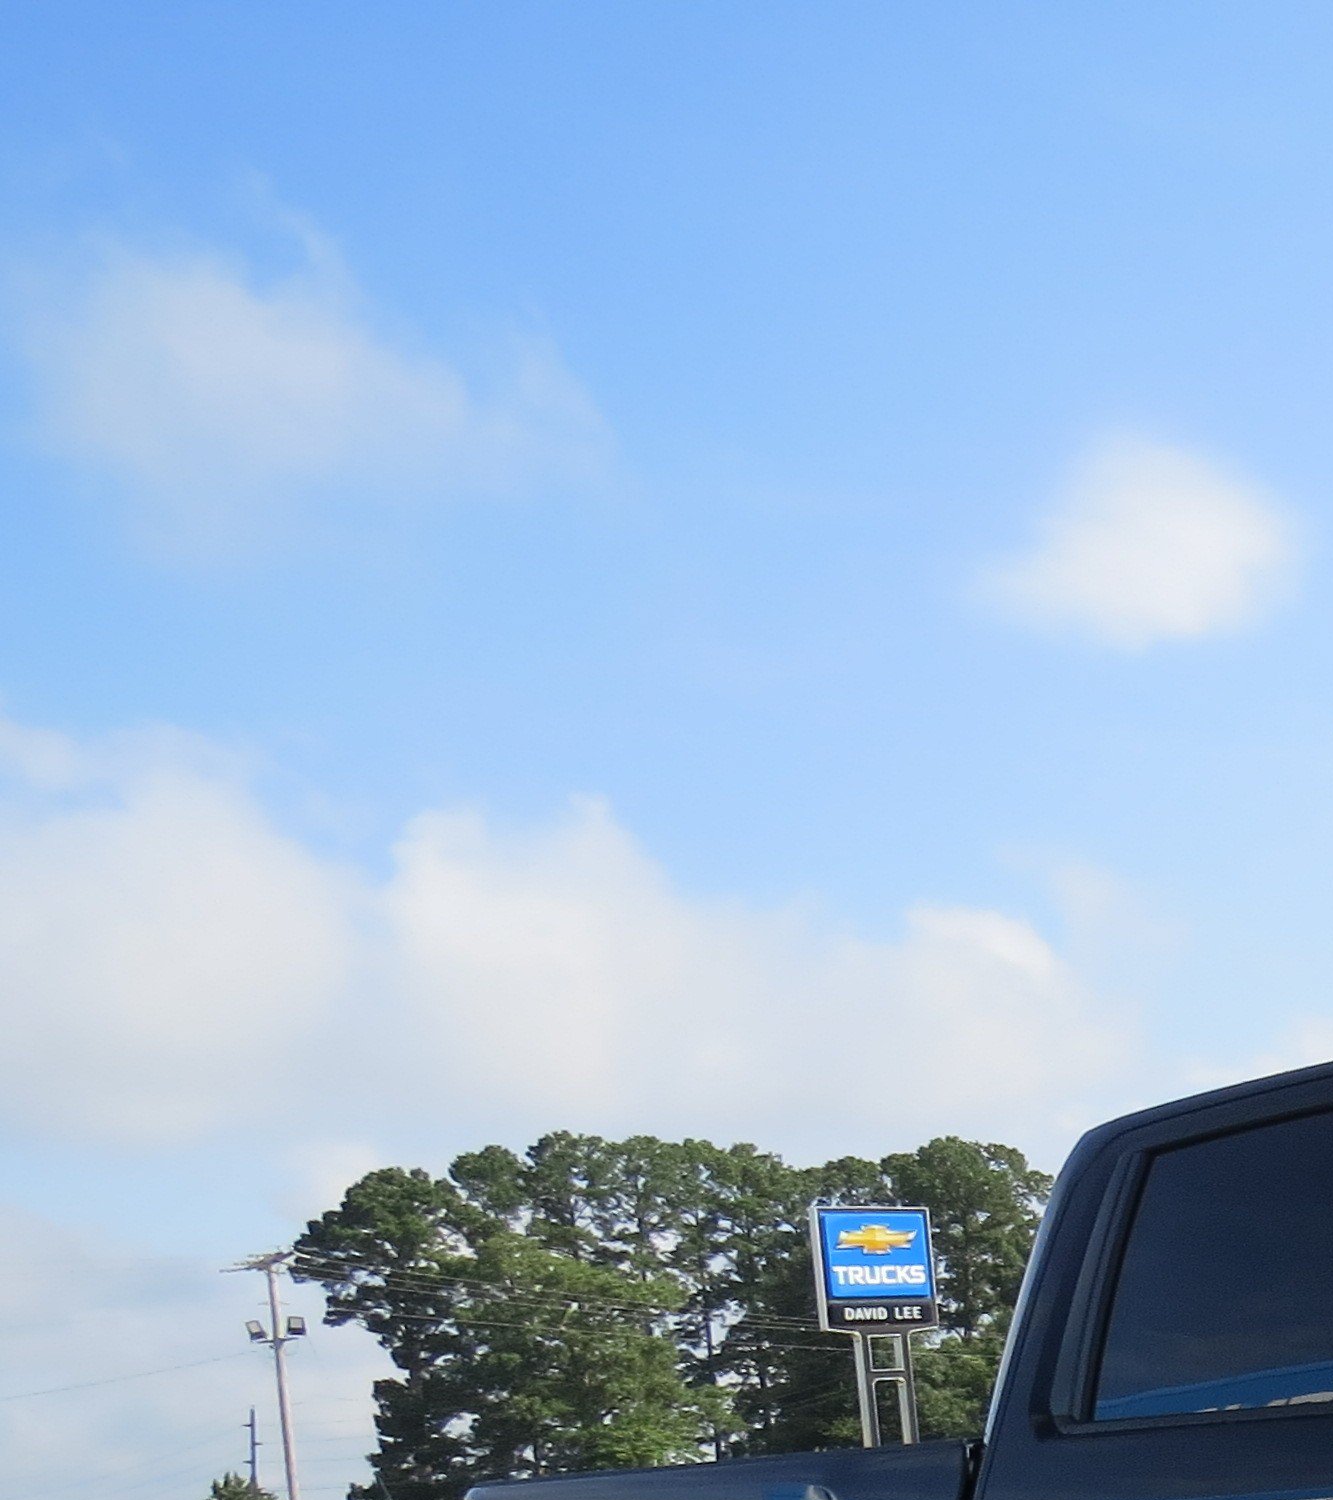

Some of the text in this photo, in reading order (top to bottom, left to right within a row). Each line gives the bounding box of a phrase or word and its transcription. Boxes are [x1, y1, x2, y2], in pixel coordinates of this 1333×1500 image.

[832, 1265, 926, 1285] TRUCKS
[844, 1306, 922, 1321] DAVID LEE
